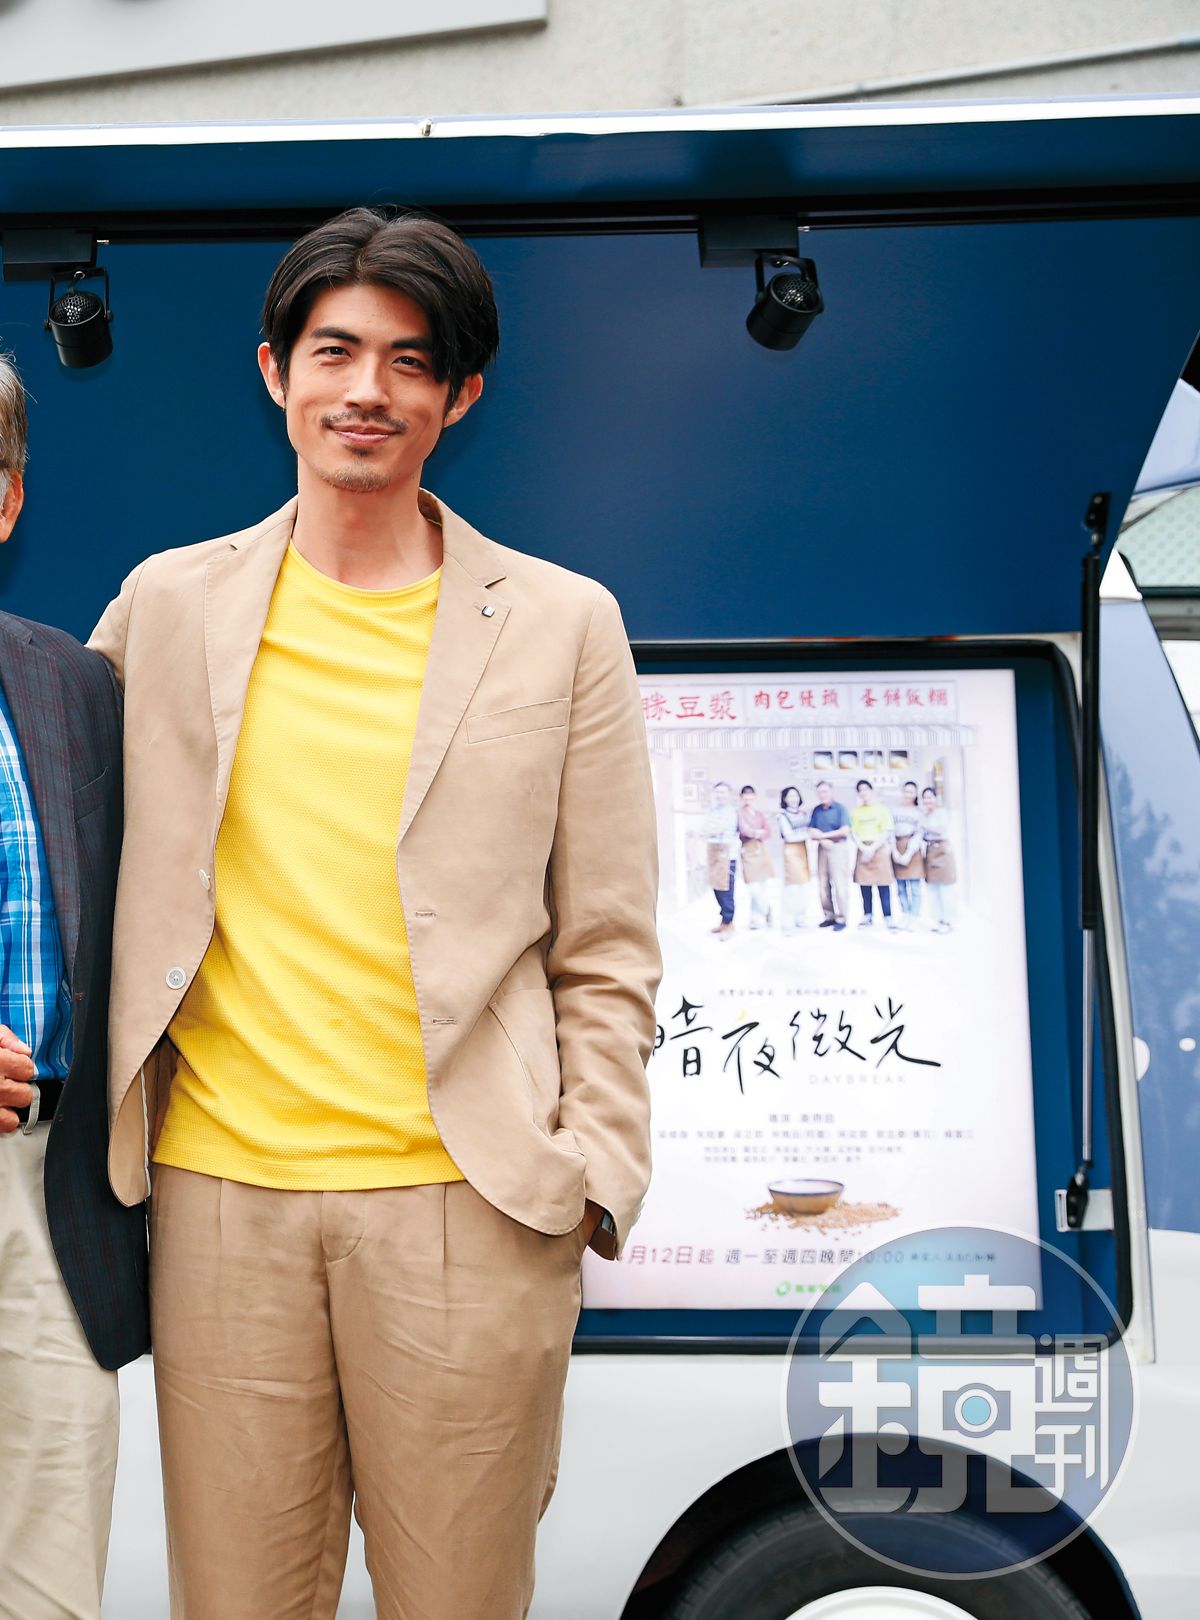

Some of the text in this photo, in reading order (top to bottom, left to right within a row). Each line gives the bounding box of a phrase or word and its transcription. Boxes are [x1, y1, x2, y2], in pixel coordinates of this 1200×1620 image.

[652, 995, 942, 1095] 暗夜微光
[619, 1245, 715, 1265] 月12日起
